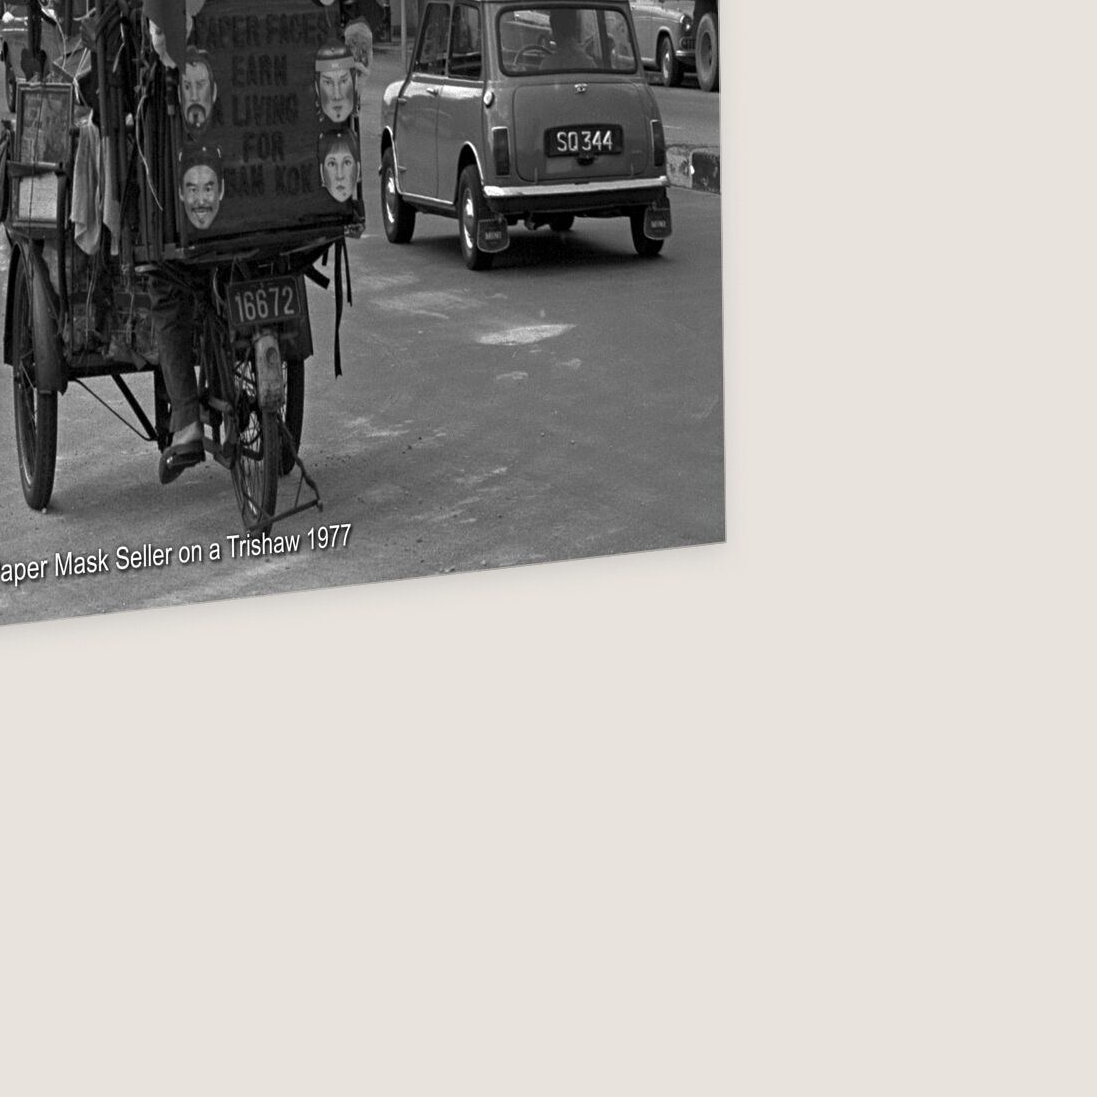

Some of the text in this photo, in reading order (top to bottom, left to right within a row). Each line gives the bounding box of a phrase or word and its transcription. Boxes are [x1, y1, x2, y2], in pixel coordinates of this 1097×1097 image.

[232, 53, 288, 87] EARN
[232, 93, 299, 128] LIVING
[243, 131, 285, 163] FOR
[581, 130, 614, 151] 344
[235, 286, 295, 322] 16672
